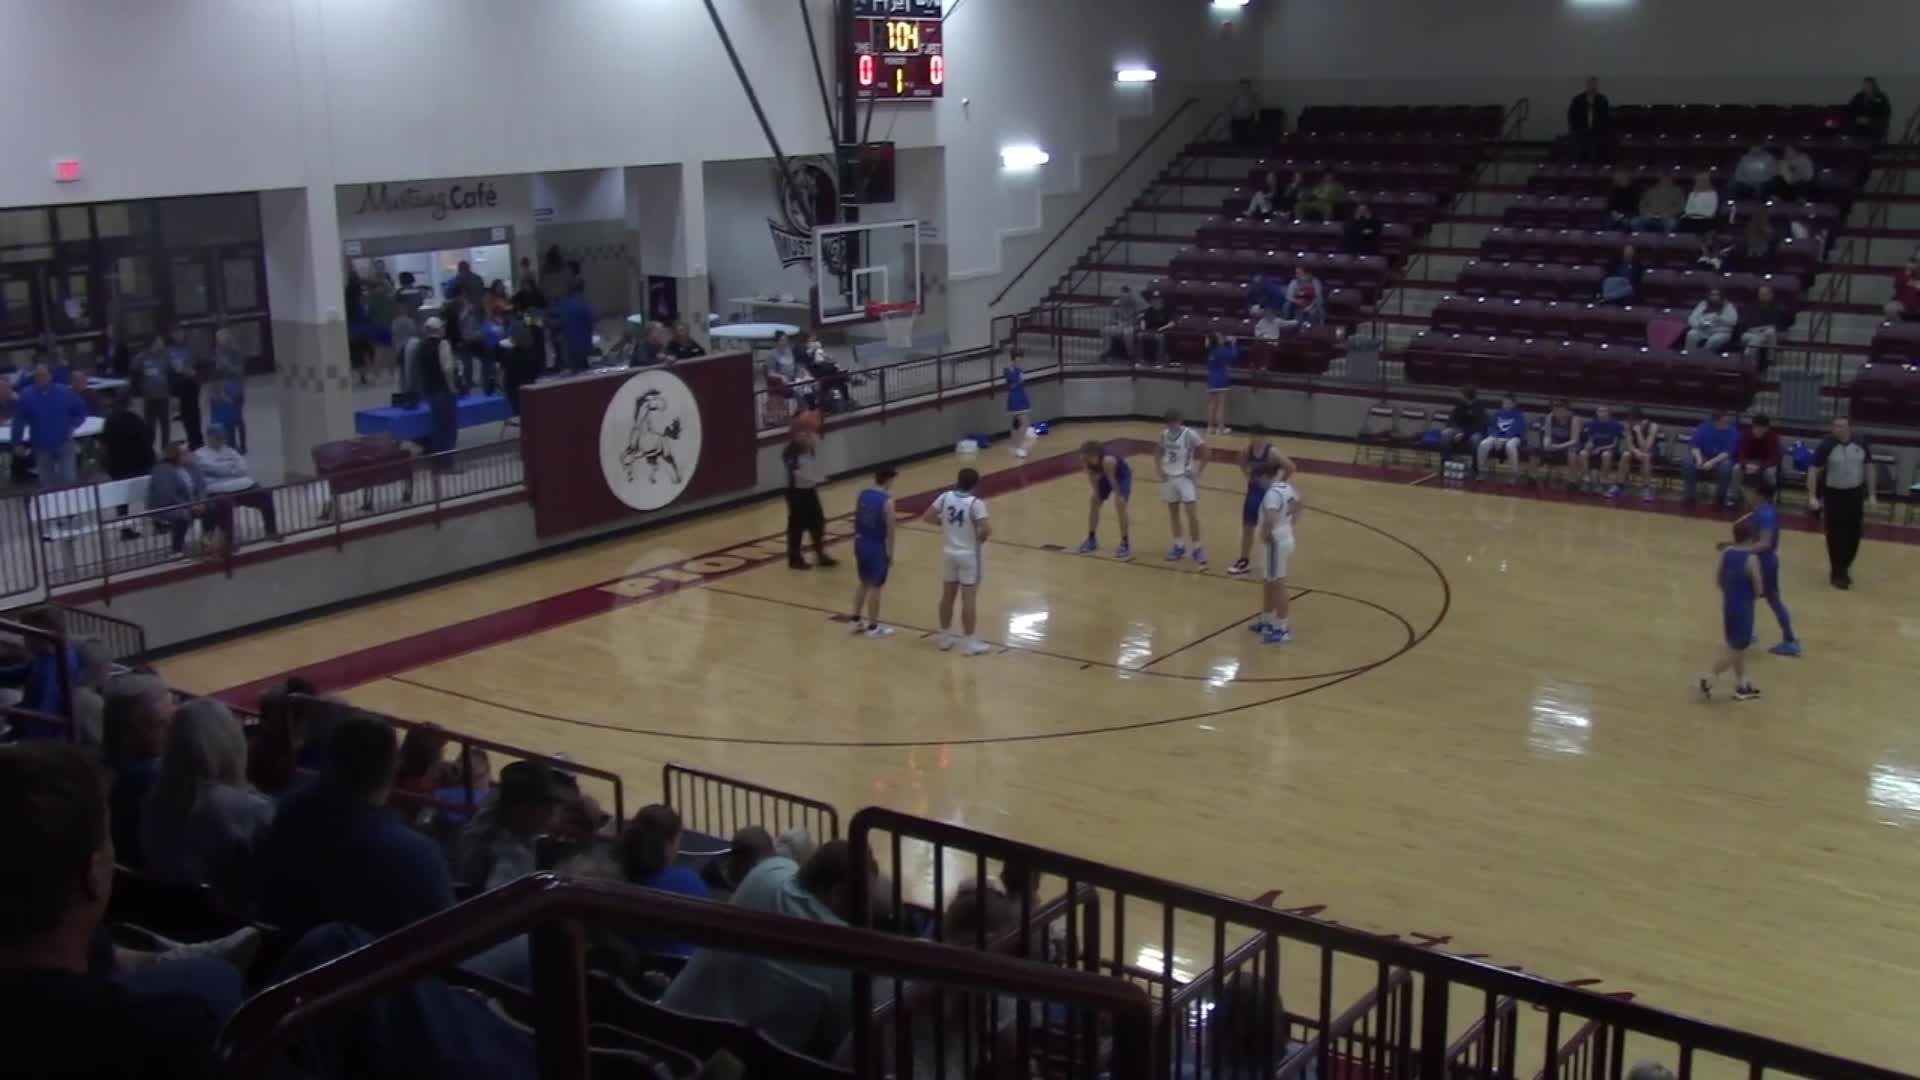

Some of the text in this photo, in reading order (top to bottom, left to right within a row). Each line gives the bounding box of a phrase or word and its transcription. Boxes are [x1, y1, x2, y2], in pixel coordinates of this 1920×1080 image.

[859, 55, 873, 85] 0
[896, 68, 903, 94] 1
[930, 55, 943, 85] 0
[947, 505, 965, 528] 34
